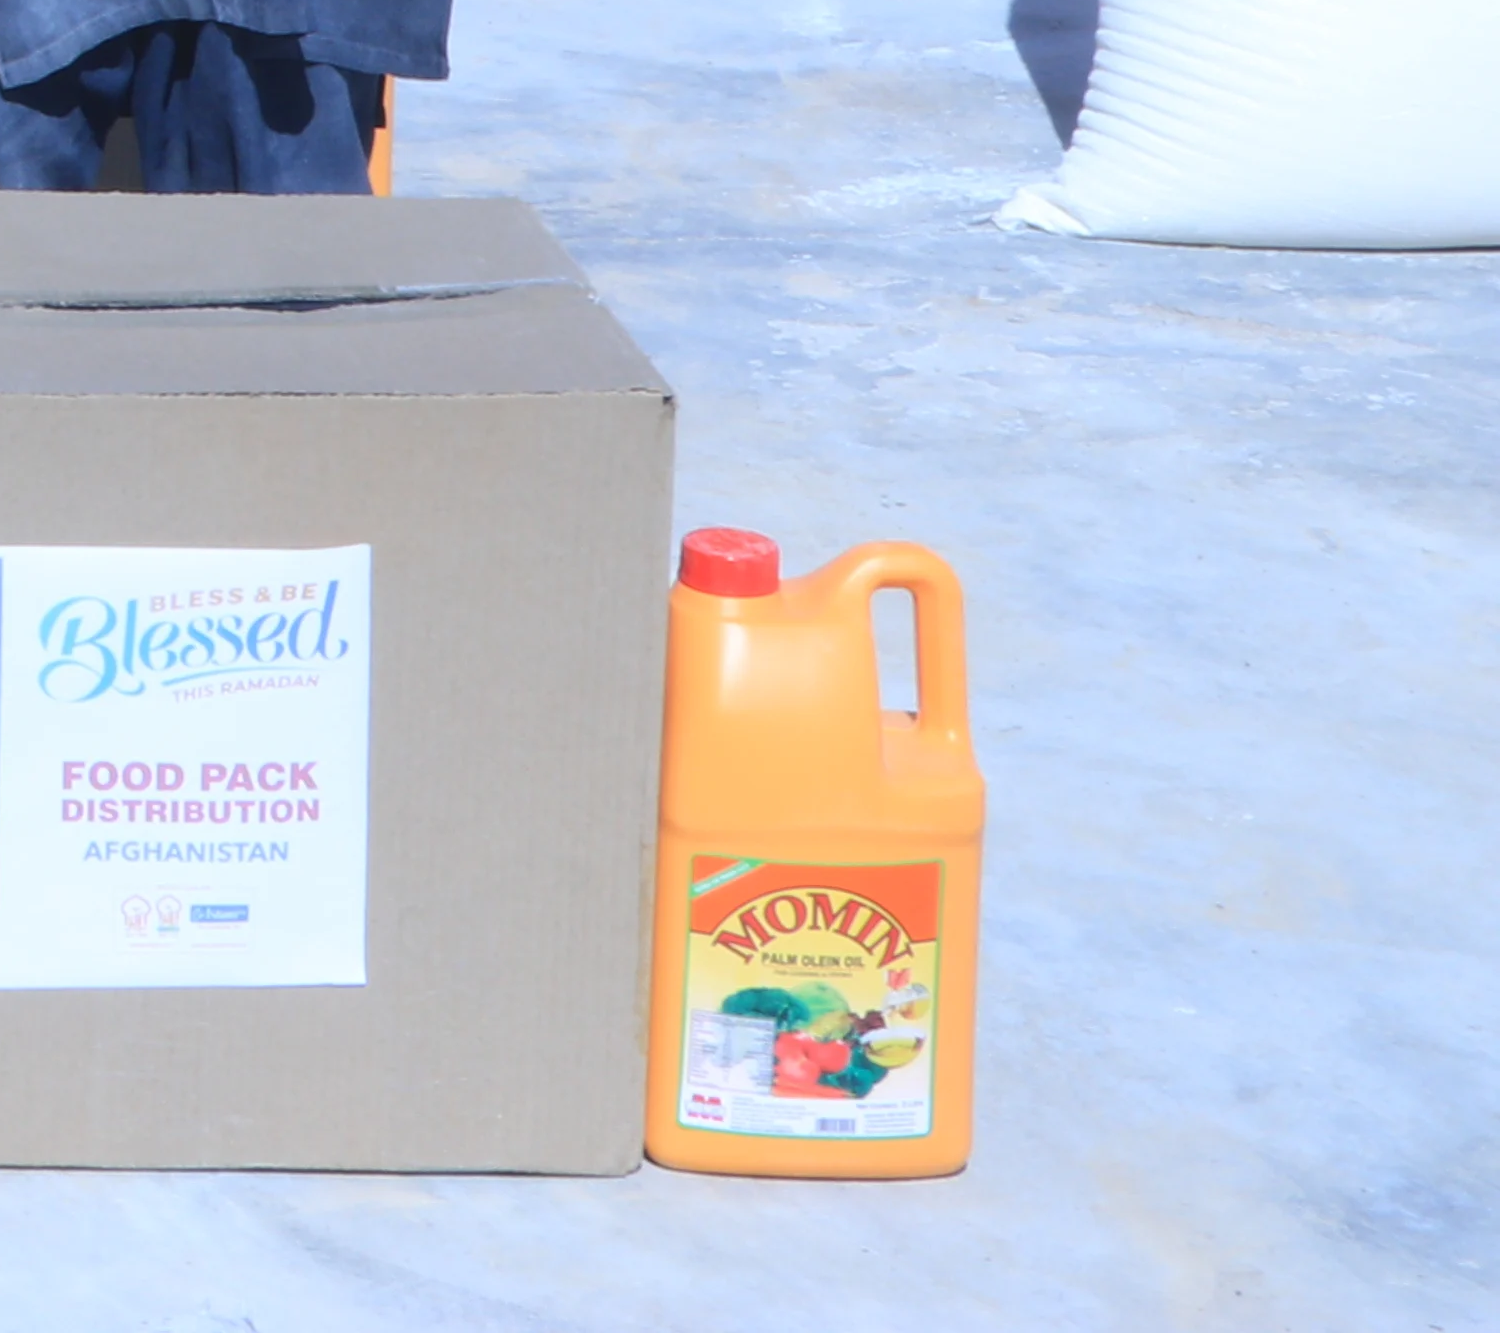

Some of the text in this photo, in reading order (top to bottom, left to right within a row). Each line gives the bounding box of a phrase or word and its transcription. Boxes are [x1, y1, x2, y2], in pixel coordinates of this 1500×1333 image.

[149, 583, 317, 613] BLESS & BE
[38, 579, 349, 703] Blessed
[172, 674, 320, 704] THIS RAMADAN
[62, 761, 318, 792] FOOD PACK
[61, 798, 319, 824] DISTRIBUTION
[84, 840, 289, 863] AFGHANISTAN
[712, 892, 914, 969] MOMIN
[761, 952, 865, 968] PALM OLEIN OIL
